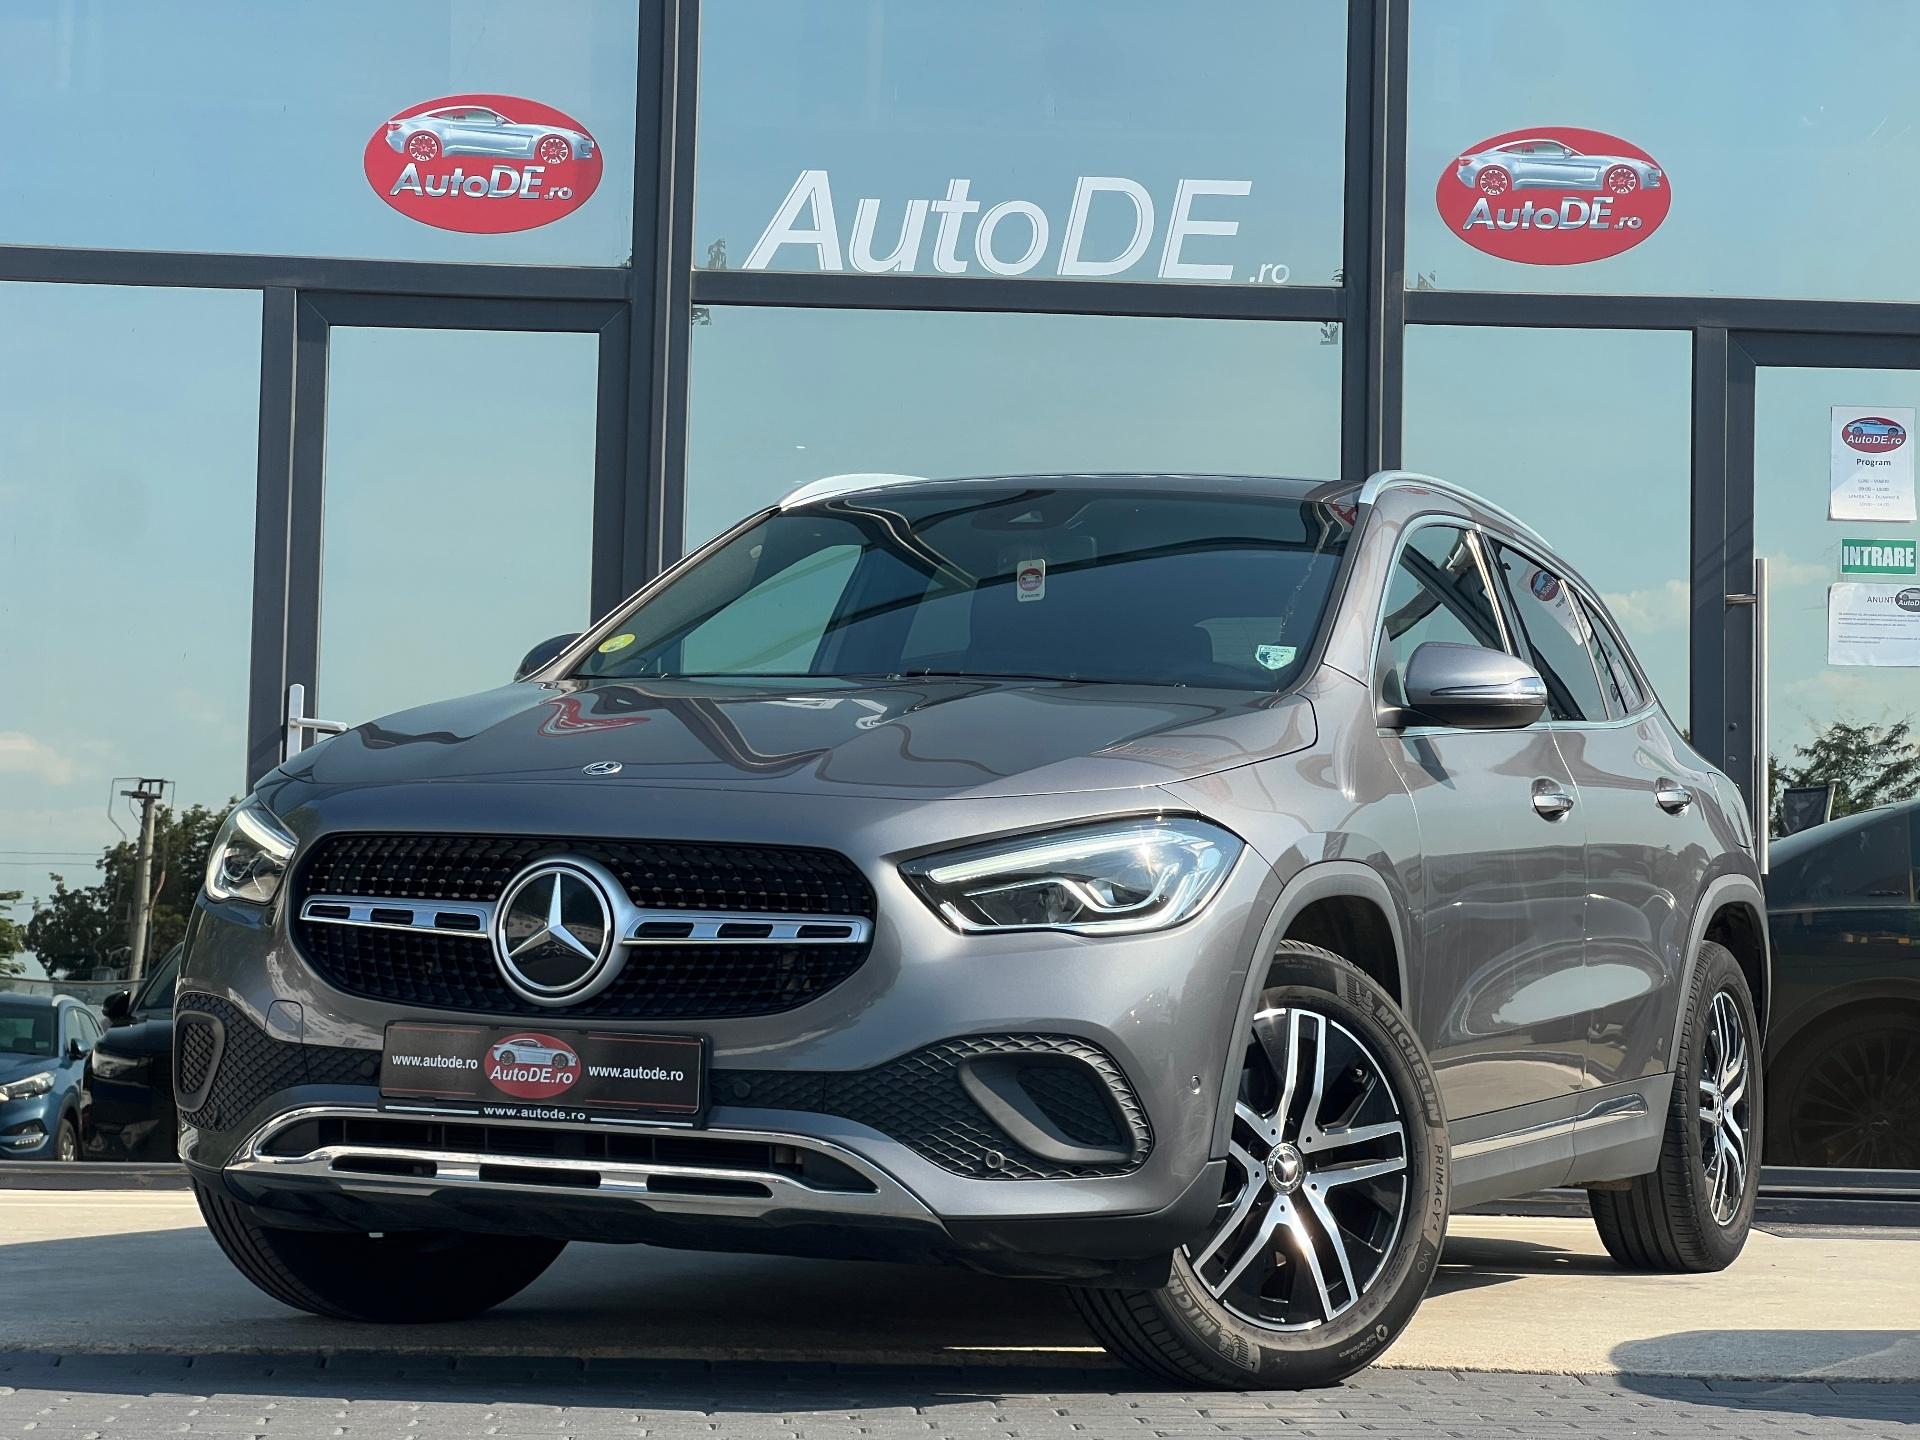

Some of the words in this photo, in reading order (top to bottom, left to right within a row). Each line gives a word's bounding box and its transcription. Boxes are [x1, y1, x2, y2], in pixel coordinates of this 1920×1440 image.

[389, 162, 573, 200] AutoDE.ro
[1462, 196, 1643, 230] AutoDE.ro
[741, 169, 1290, 285] AutoDE.ro
[1847, 434, 1902, 445] AutoDE.ro
[1856, 458, 1892, 467] Program
[1843, 546, 1915, 567] INTRARE
[391, 1053, 479, 1070] www.autode.ro
[588, 1063, 685, 1082] www.autode.ro
[1375, 1004, 1441, 1121] MICHELIN
[489, 1065, 574, 1085] AutoDE.ro
[482, 1105, 587, 1121] www.autode.ro
[1432, 1144, 1444, 1222] PRIMACY
[1417, 1250, 1431, 1273] MO
[1167, 1278, 1217, 1337] MICH
